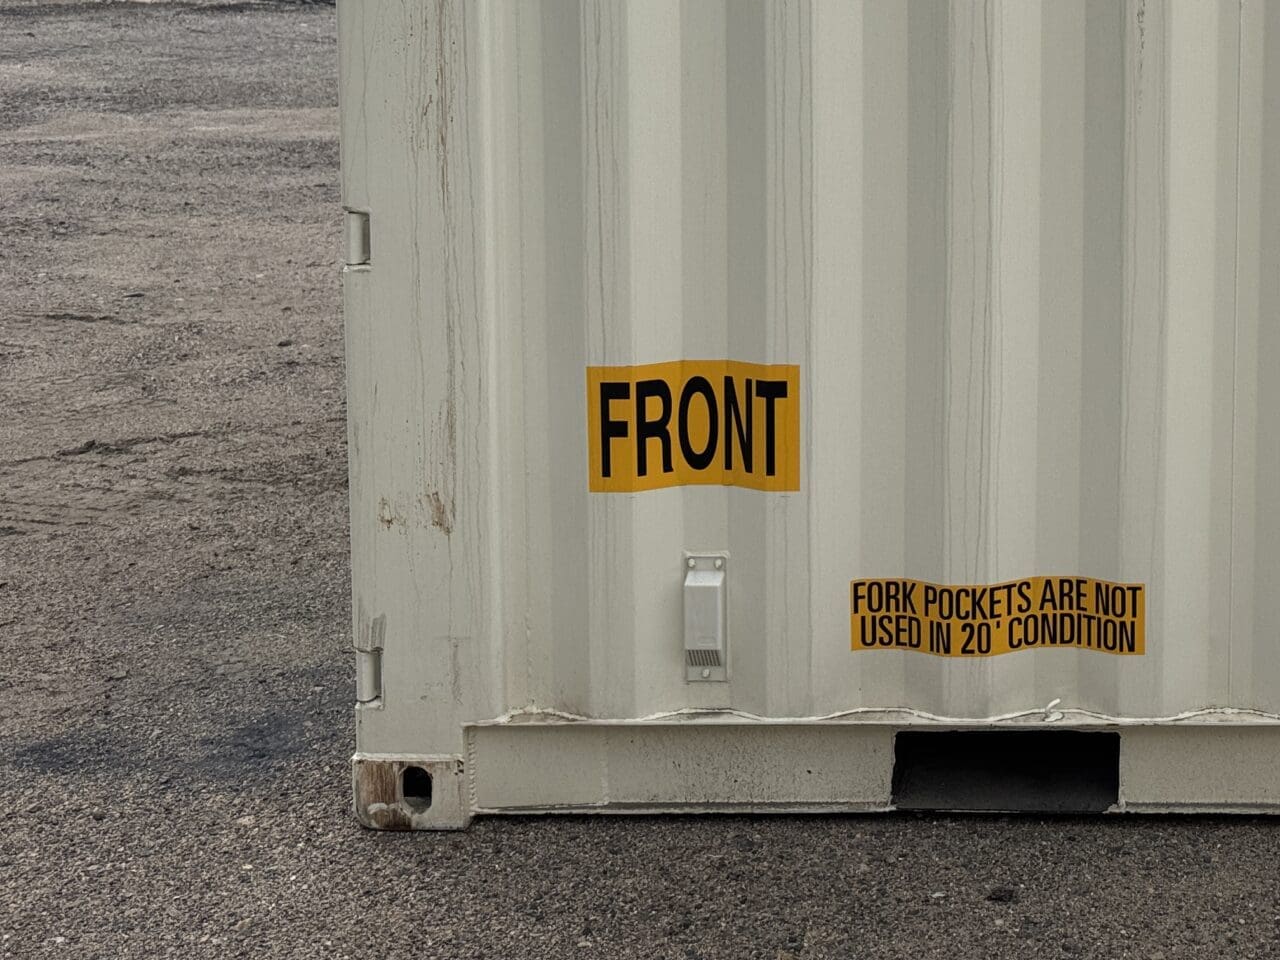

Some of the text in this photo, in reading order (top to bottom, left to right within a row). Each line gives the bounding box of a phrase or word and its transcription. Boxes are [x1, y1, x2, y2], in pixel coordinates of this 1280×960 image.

[600, 375, 788, 478] FRONT
[853, 579, 1142, 620] FORK POCKETS ARE NOT
[860, 612, 1136, 655] USED IN 20' CONDITION
